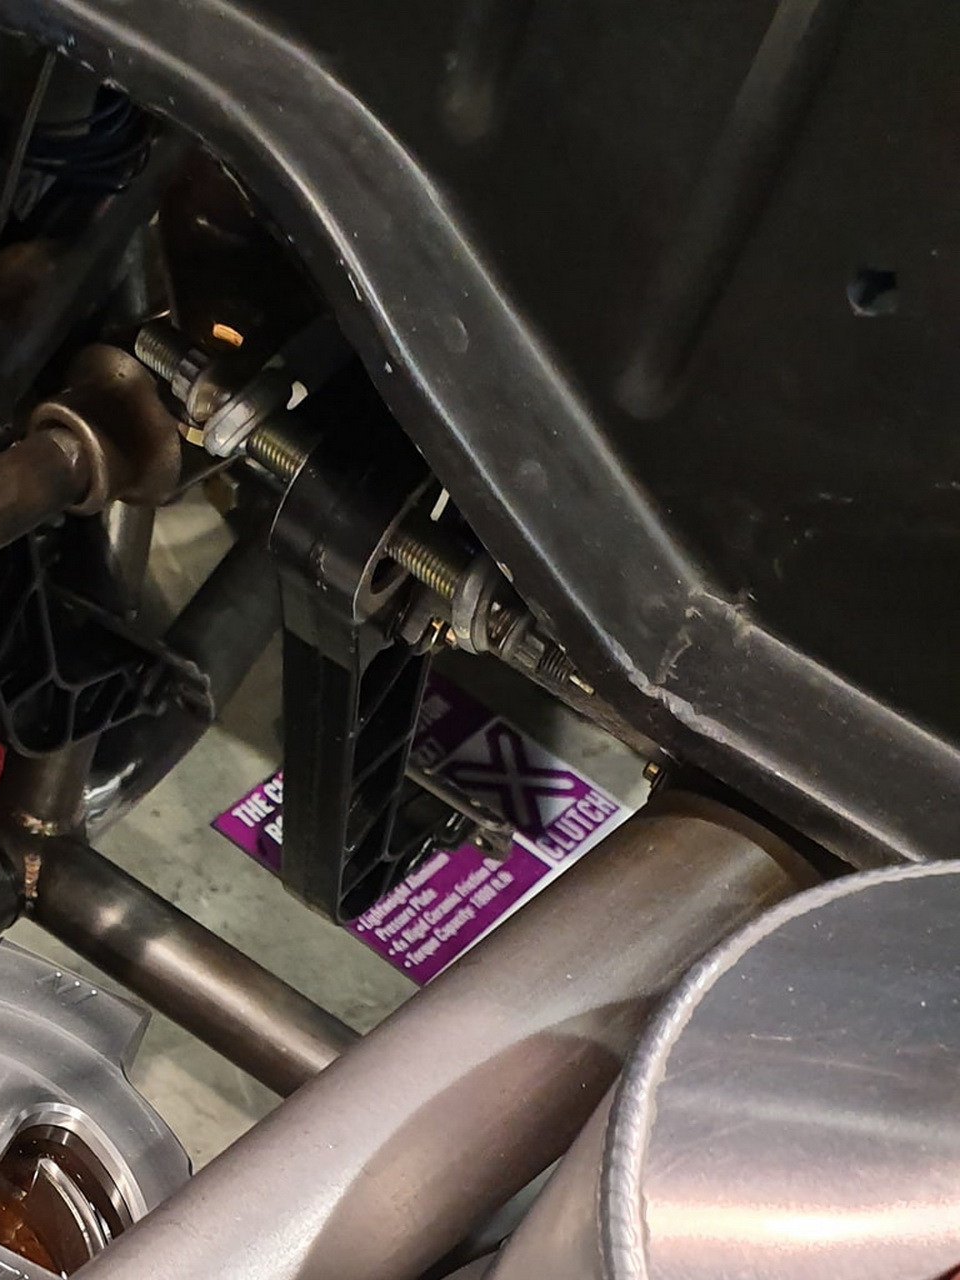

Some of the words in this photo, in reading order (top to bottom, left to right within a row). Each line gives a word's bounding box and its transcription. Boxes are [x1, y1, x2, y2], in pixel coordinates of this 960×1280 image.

[231, 792, 275, 828] THE
[536, 790, 617, 862] CLUTCH
[374, 906, 417, 942] Pressure
[409, 888, 438, 911] Plate
[401, 916, 432, 944] Rigid
[423, 892, 463, 925] Ceramic
[405, 936, 441, 965] Torque
